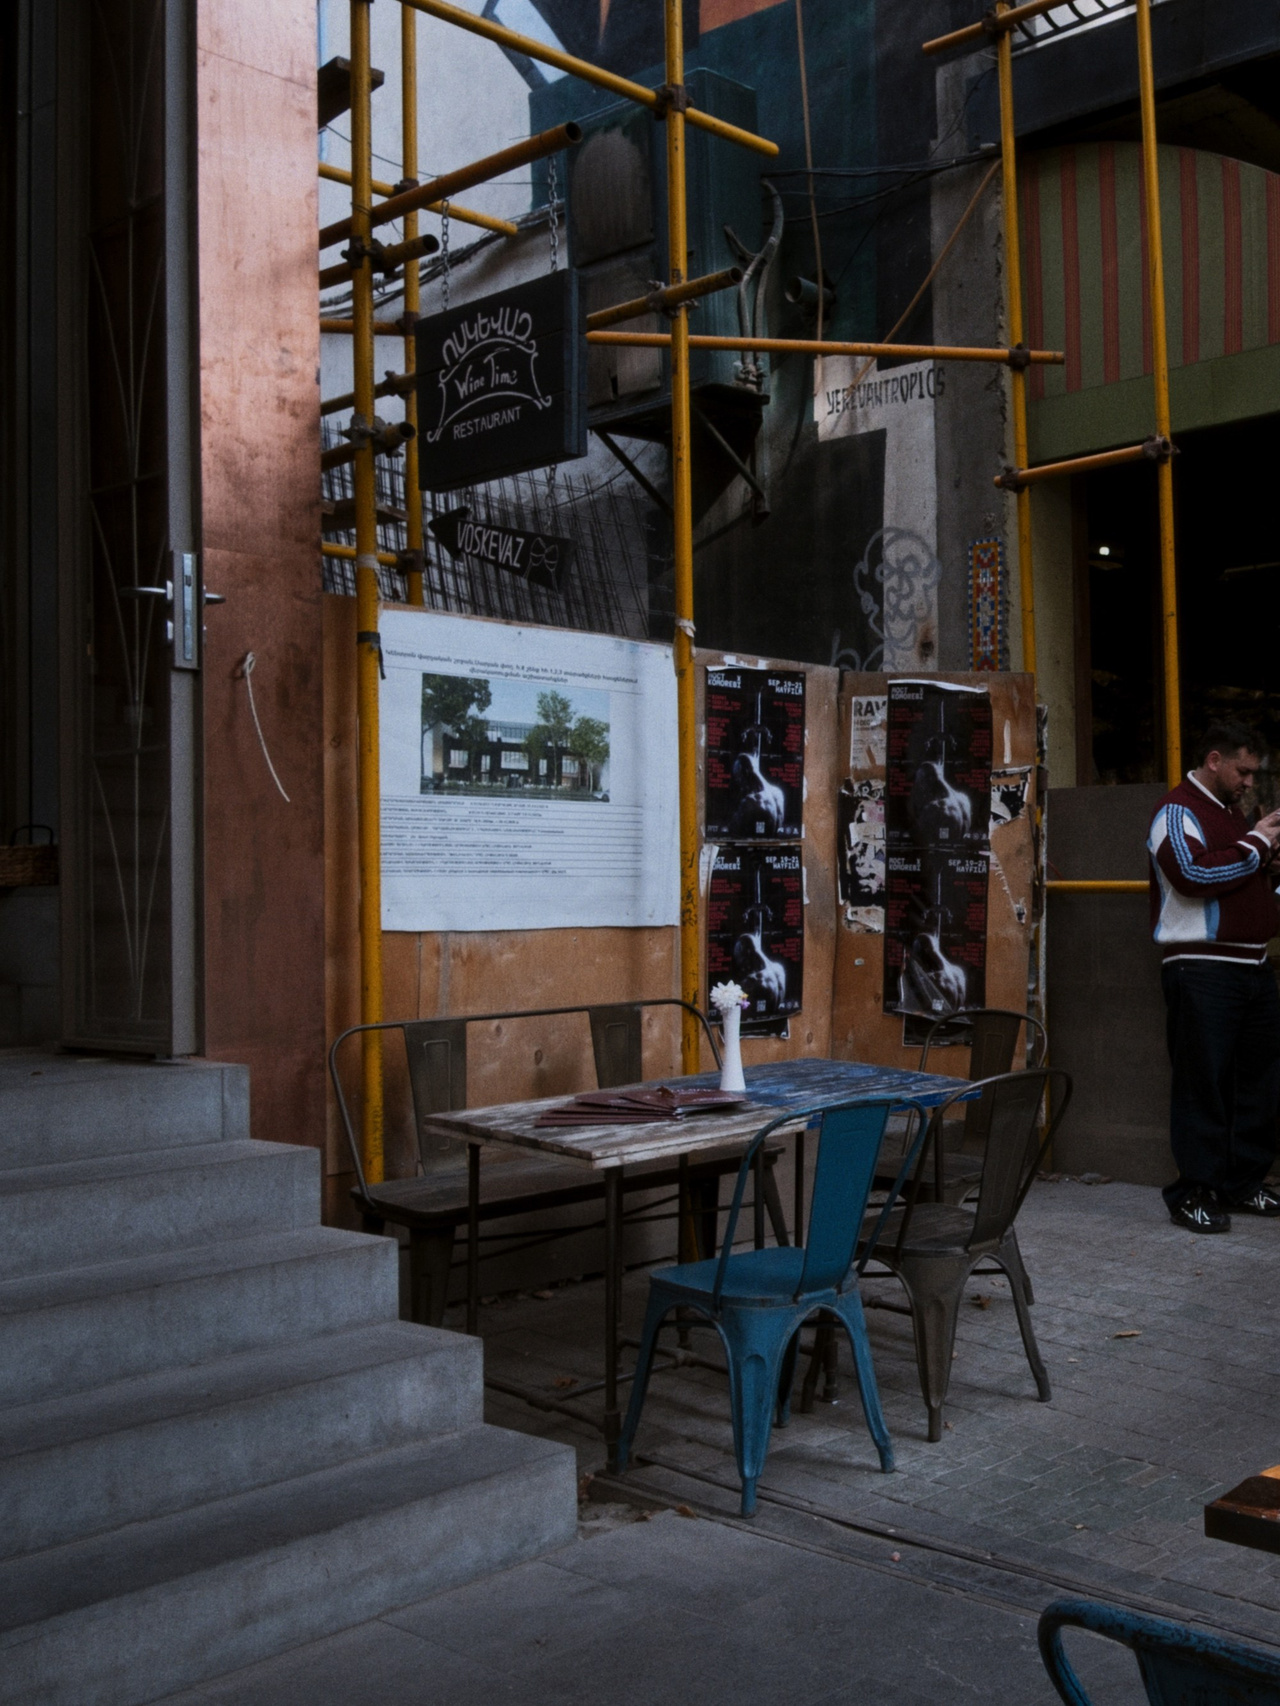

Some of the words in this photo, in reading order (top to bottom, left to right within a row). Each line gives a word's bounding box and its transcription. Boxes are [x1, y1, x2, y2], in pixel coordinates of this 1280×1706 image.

[454, 364, 485, 399] Wine
[483, 347, 518, 389] Time
[453, 406, 522, 440] RESTAURANT
[456, 521, 525, 568] VOSKEVAZ
[767, 678, 781, 687] SEP
[775, 686, 803, 696] HAYFILM
[765, 856, 778, 864] SEP
[948, 858, 962, 867] SEP
[712, 863, 741, 871] OMOREBI
[956, 866, 988, 874] HAYFILM
